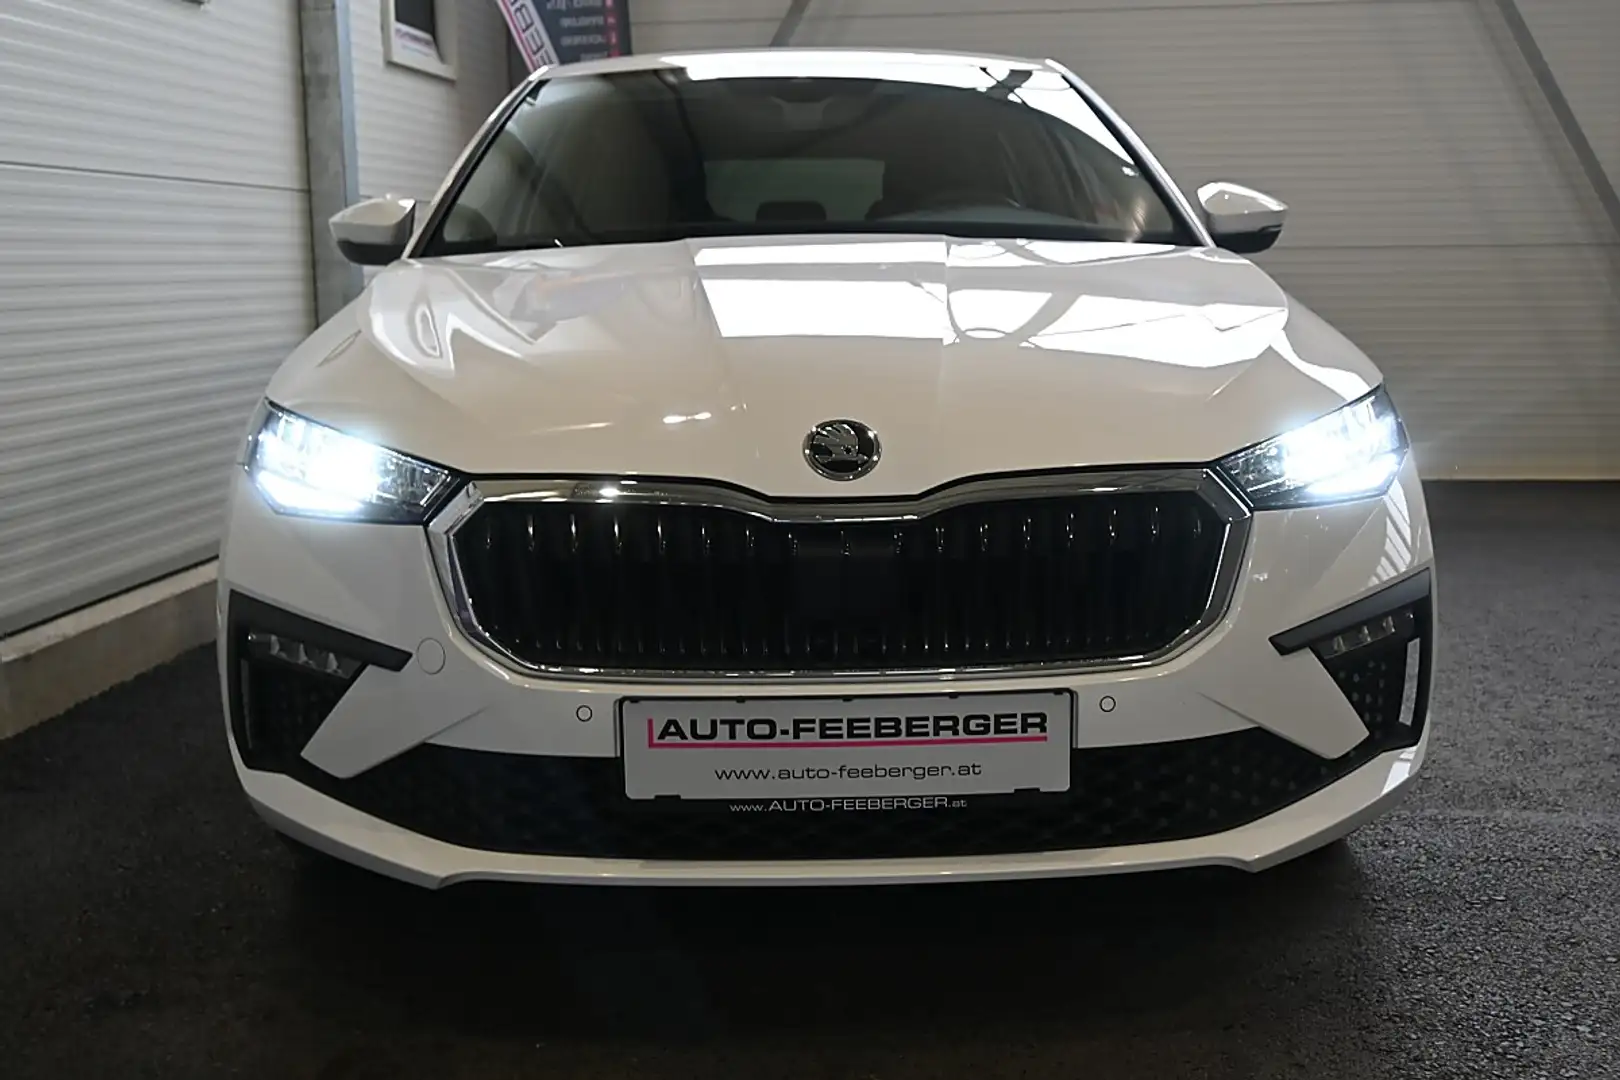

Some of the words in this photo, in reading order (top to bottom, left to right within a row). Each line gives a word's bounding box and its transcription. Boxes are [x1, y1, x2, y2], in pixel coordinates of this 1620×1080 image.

[657, 712, 1048, 741] AUTO-FEEBERGER
[714, 763, 982, 780] www.auto-feeberger.at
[729, 796, 967, 812] www.AUTO-FEEBERGER.at
